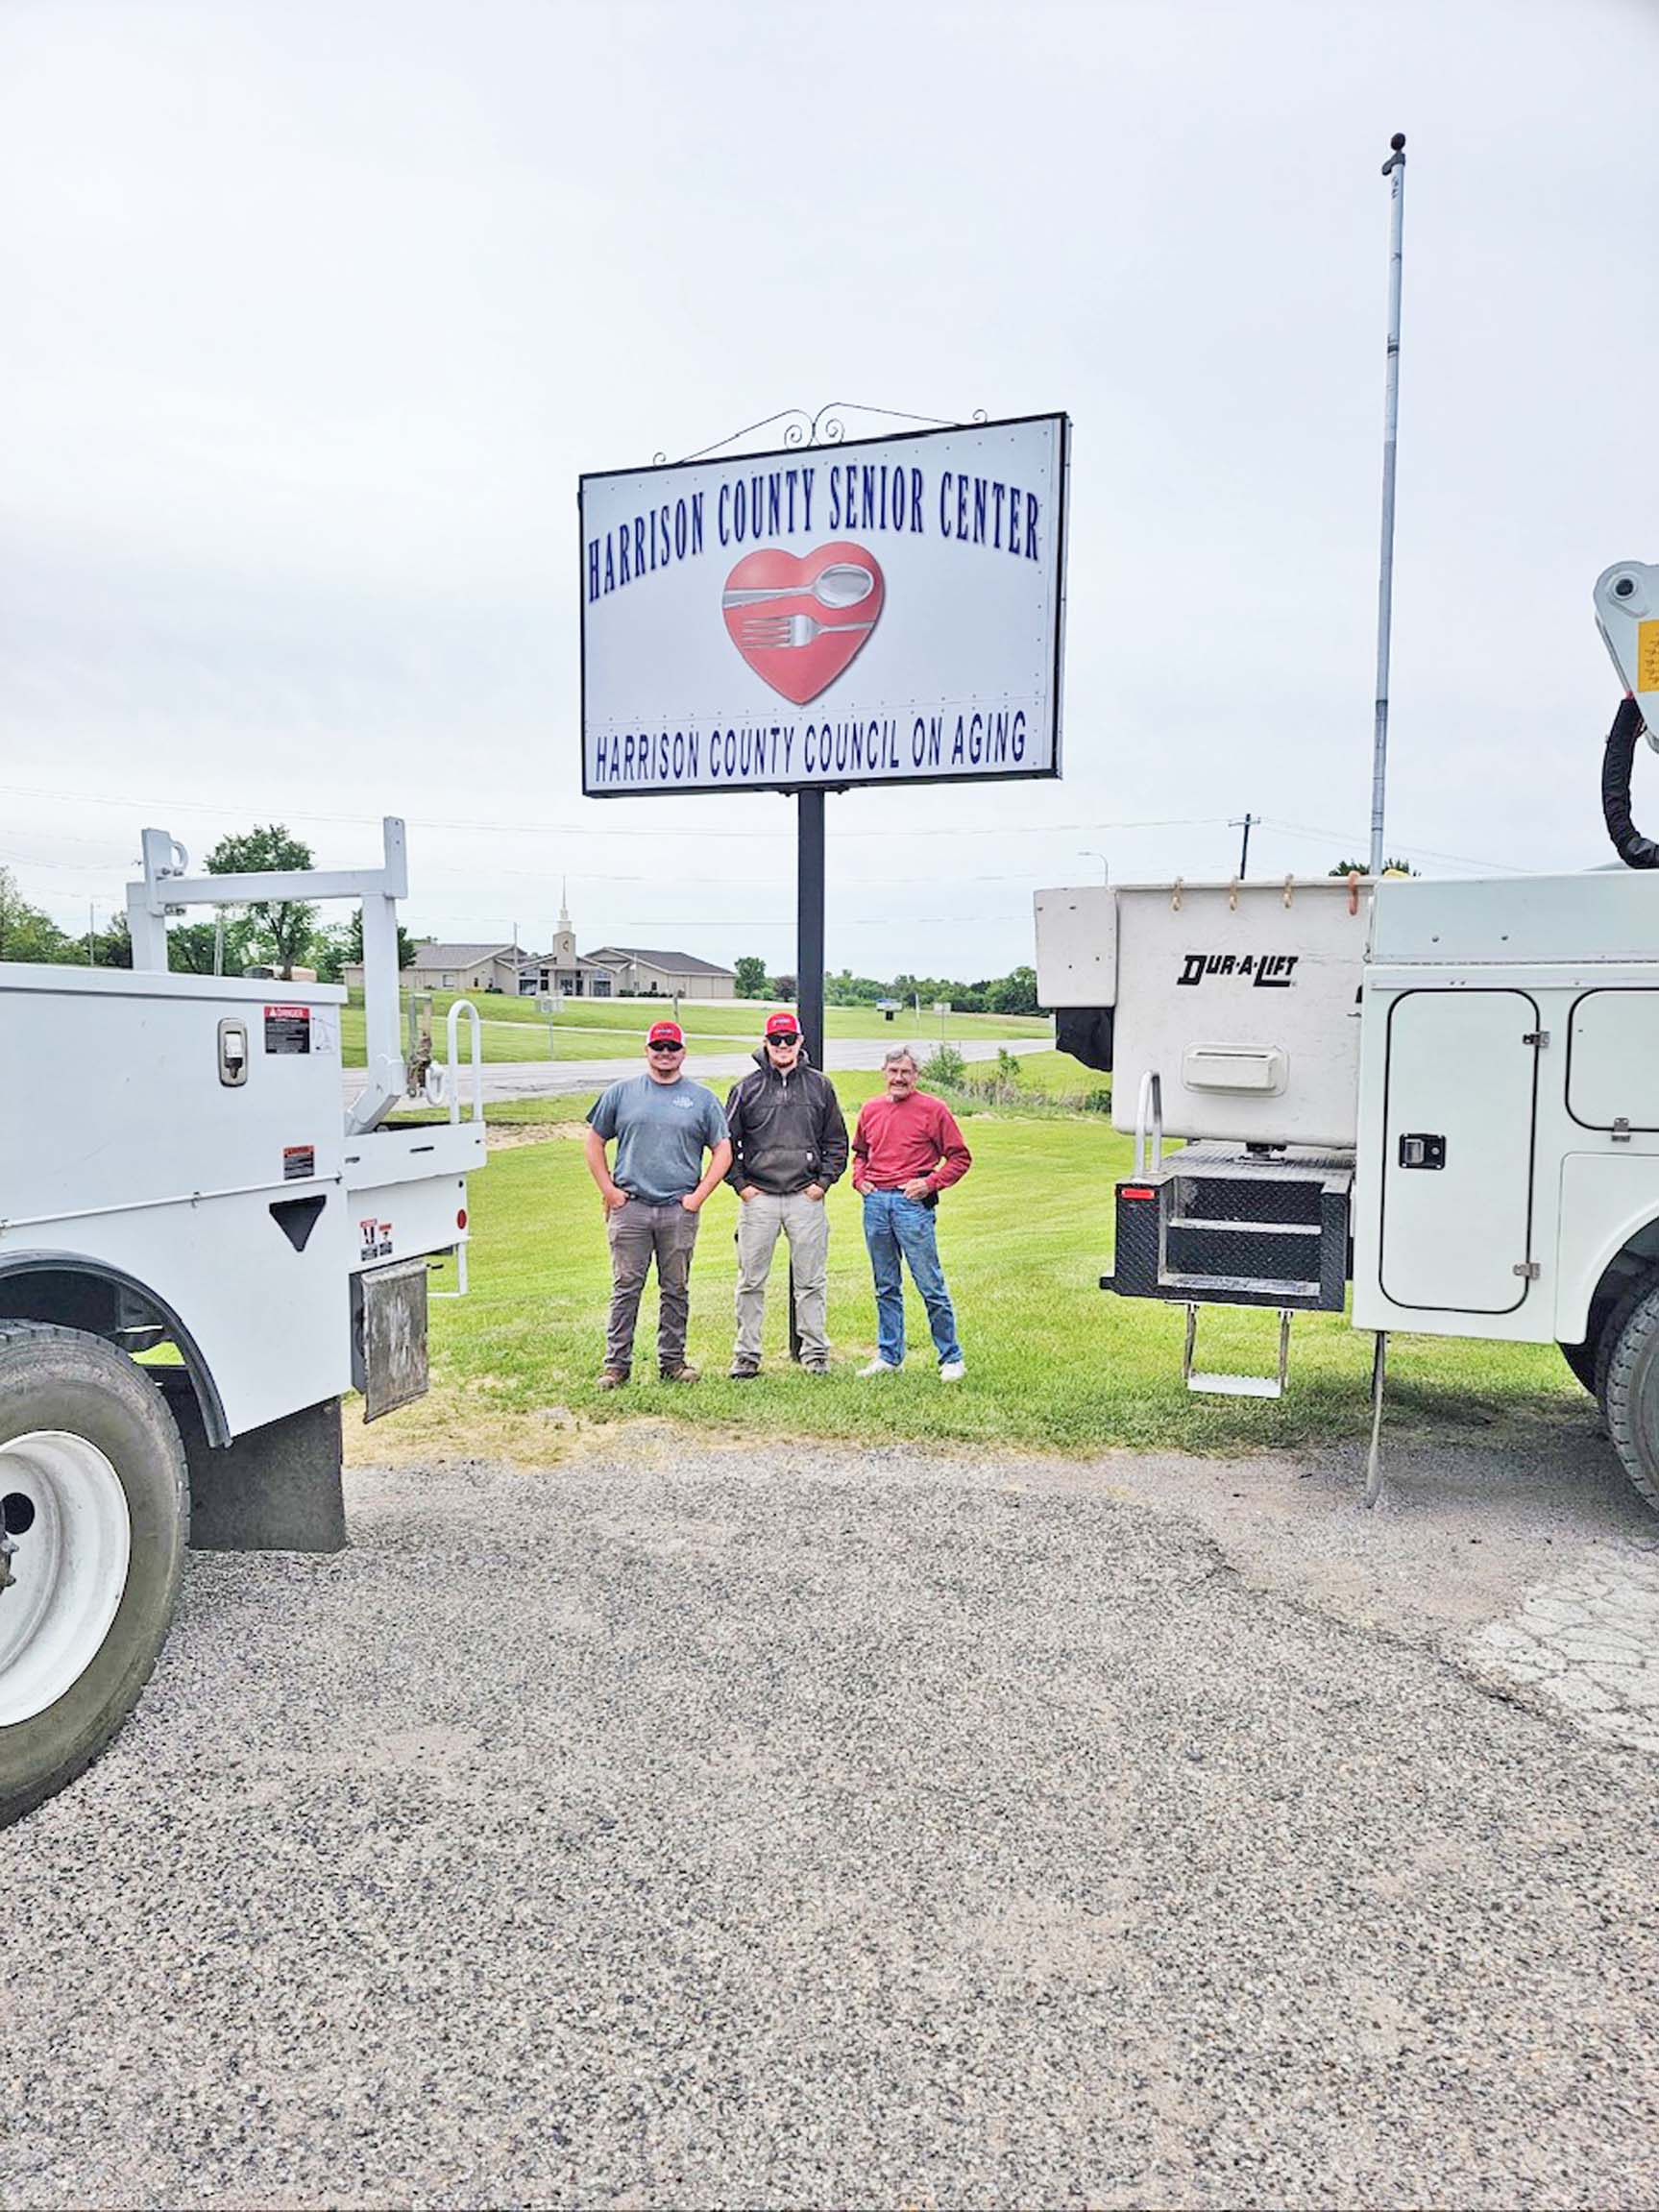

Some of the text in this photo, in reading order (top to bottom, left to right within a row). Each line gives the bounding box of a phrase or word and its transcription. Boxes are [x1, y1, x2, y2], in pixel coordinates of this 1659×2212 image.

[589, 465, 1039, 603] HARRISON COUNTY SENIOR CENTER
[597, 710, 1026, 782] HARRISON COUNTY COUNCIL ON AGING
